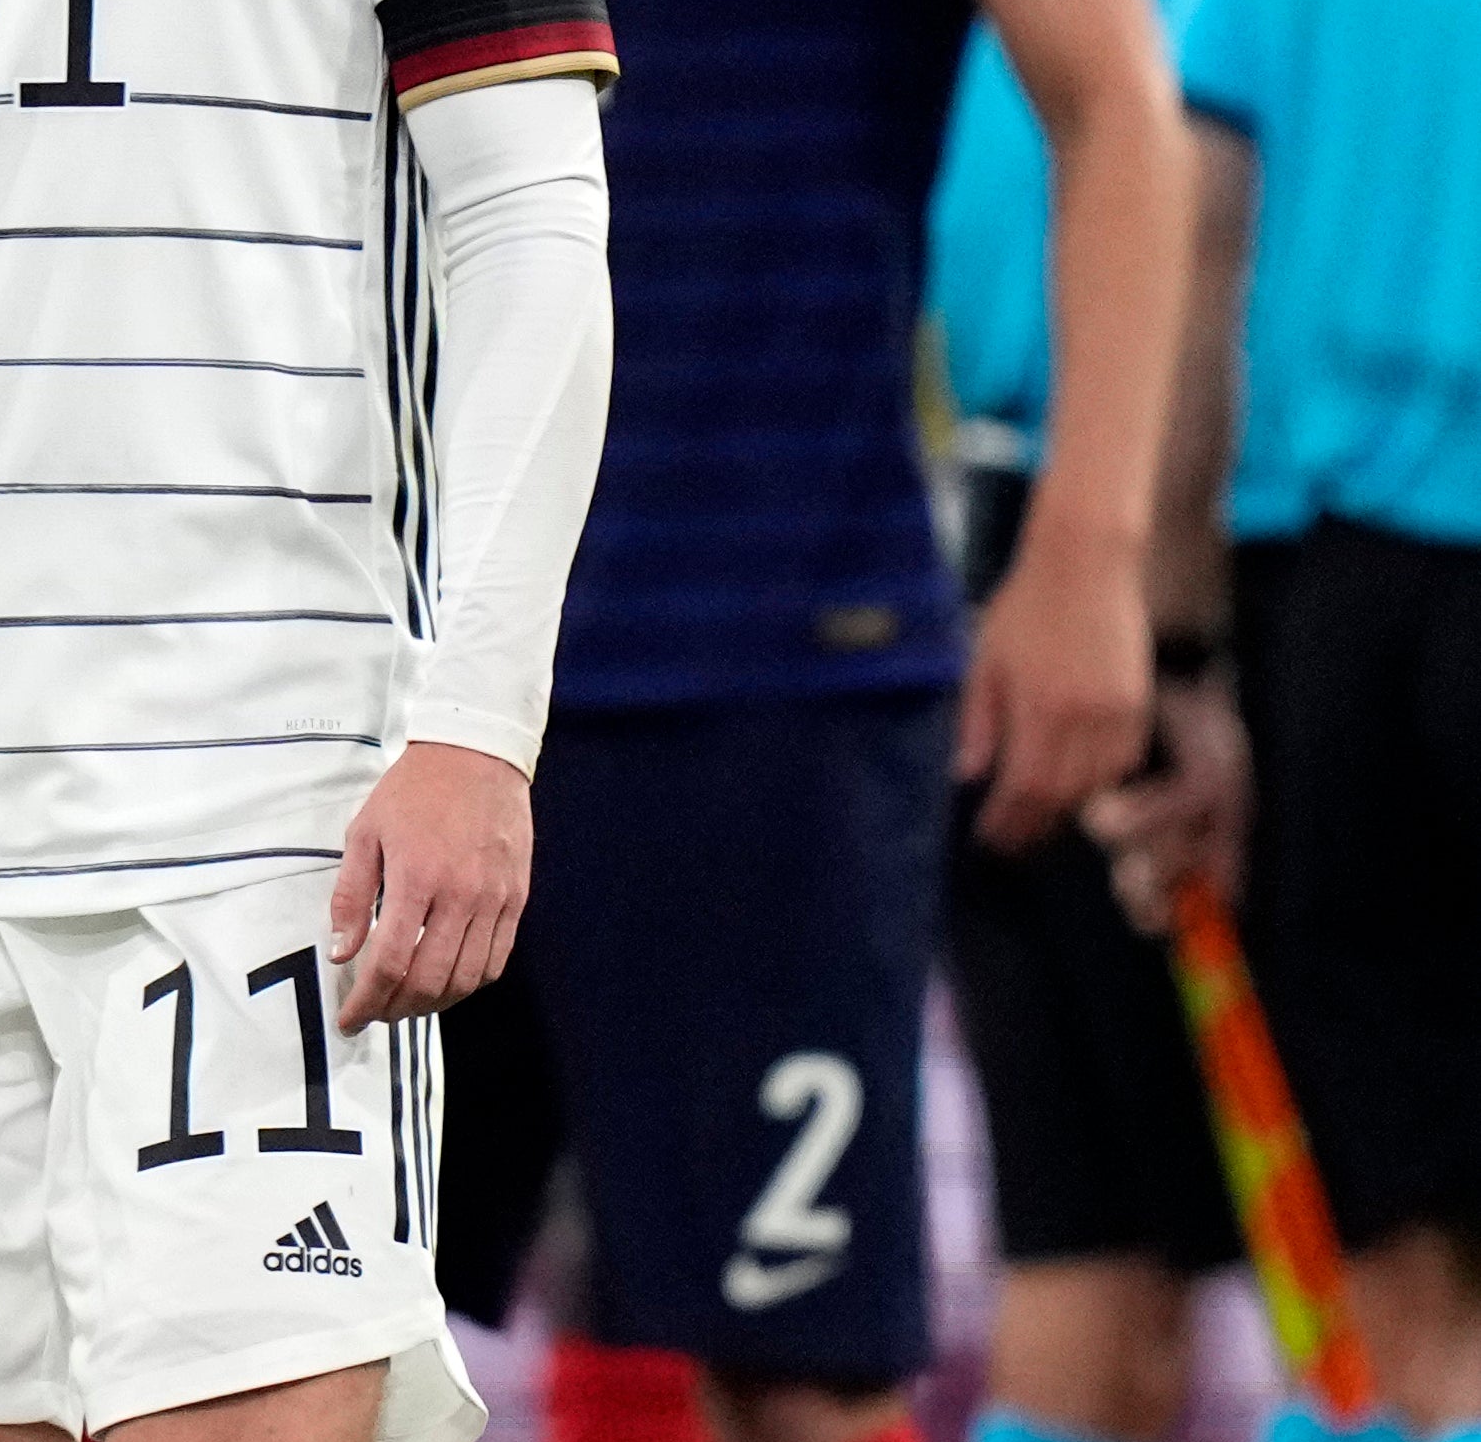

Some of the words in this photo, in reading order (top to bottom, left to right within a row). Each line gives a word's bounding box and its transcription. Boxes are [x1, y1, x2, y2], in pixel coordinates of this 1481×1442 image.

[137, 944, 363, 1173] 11
[741, 1048, 865, 1255] 2
[263, 1245, 363, 1280] adidas
